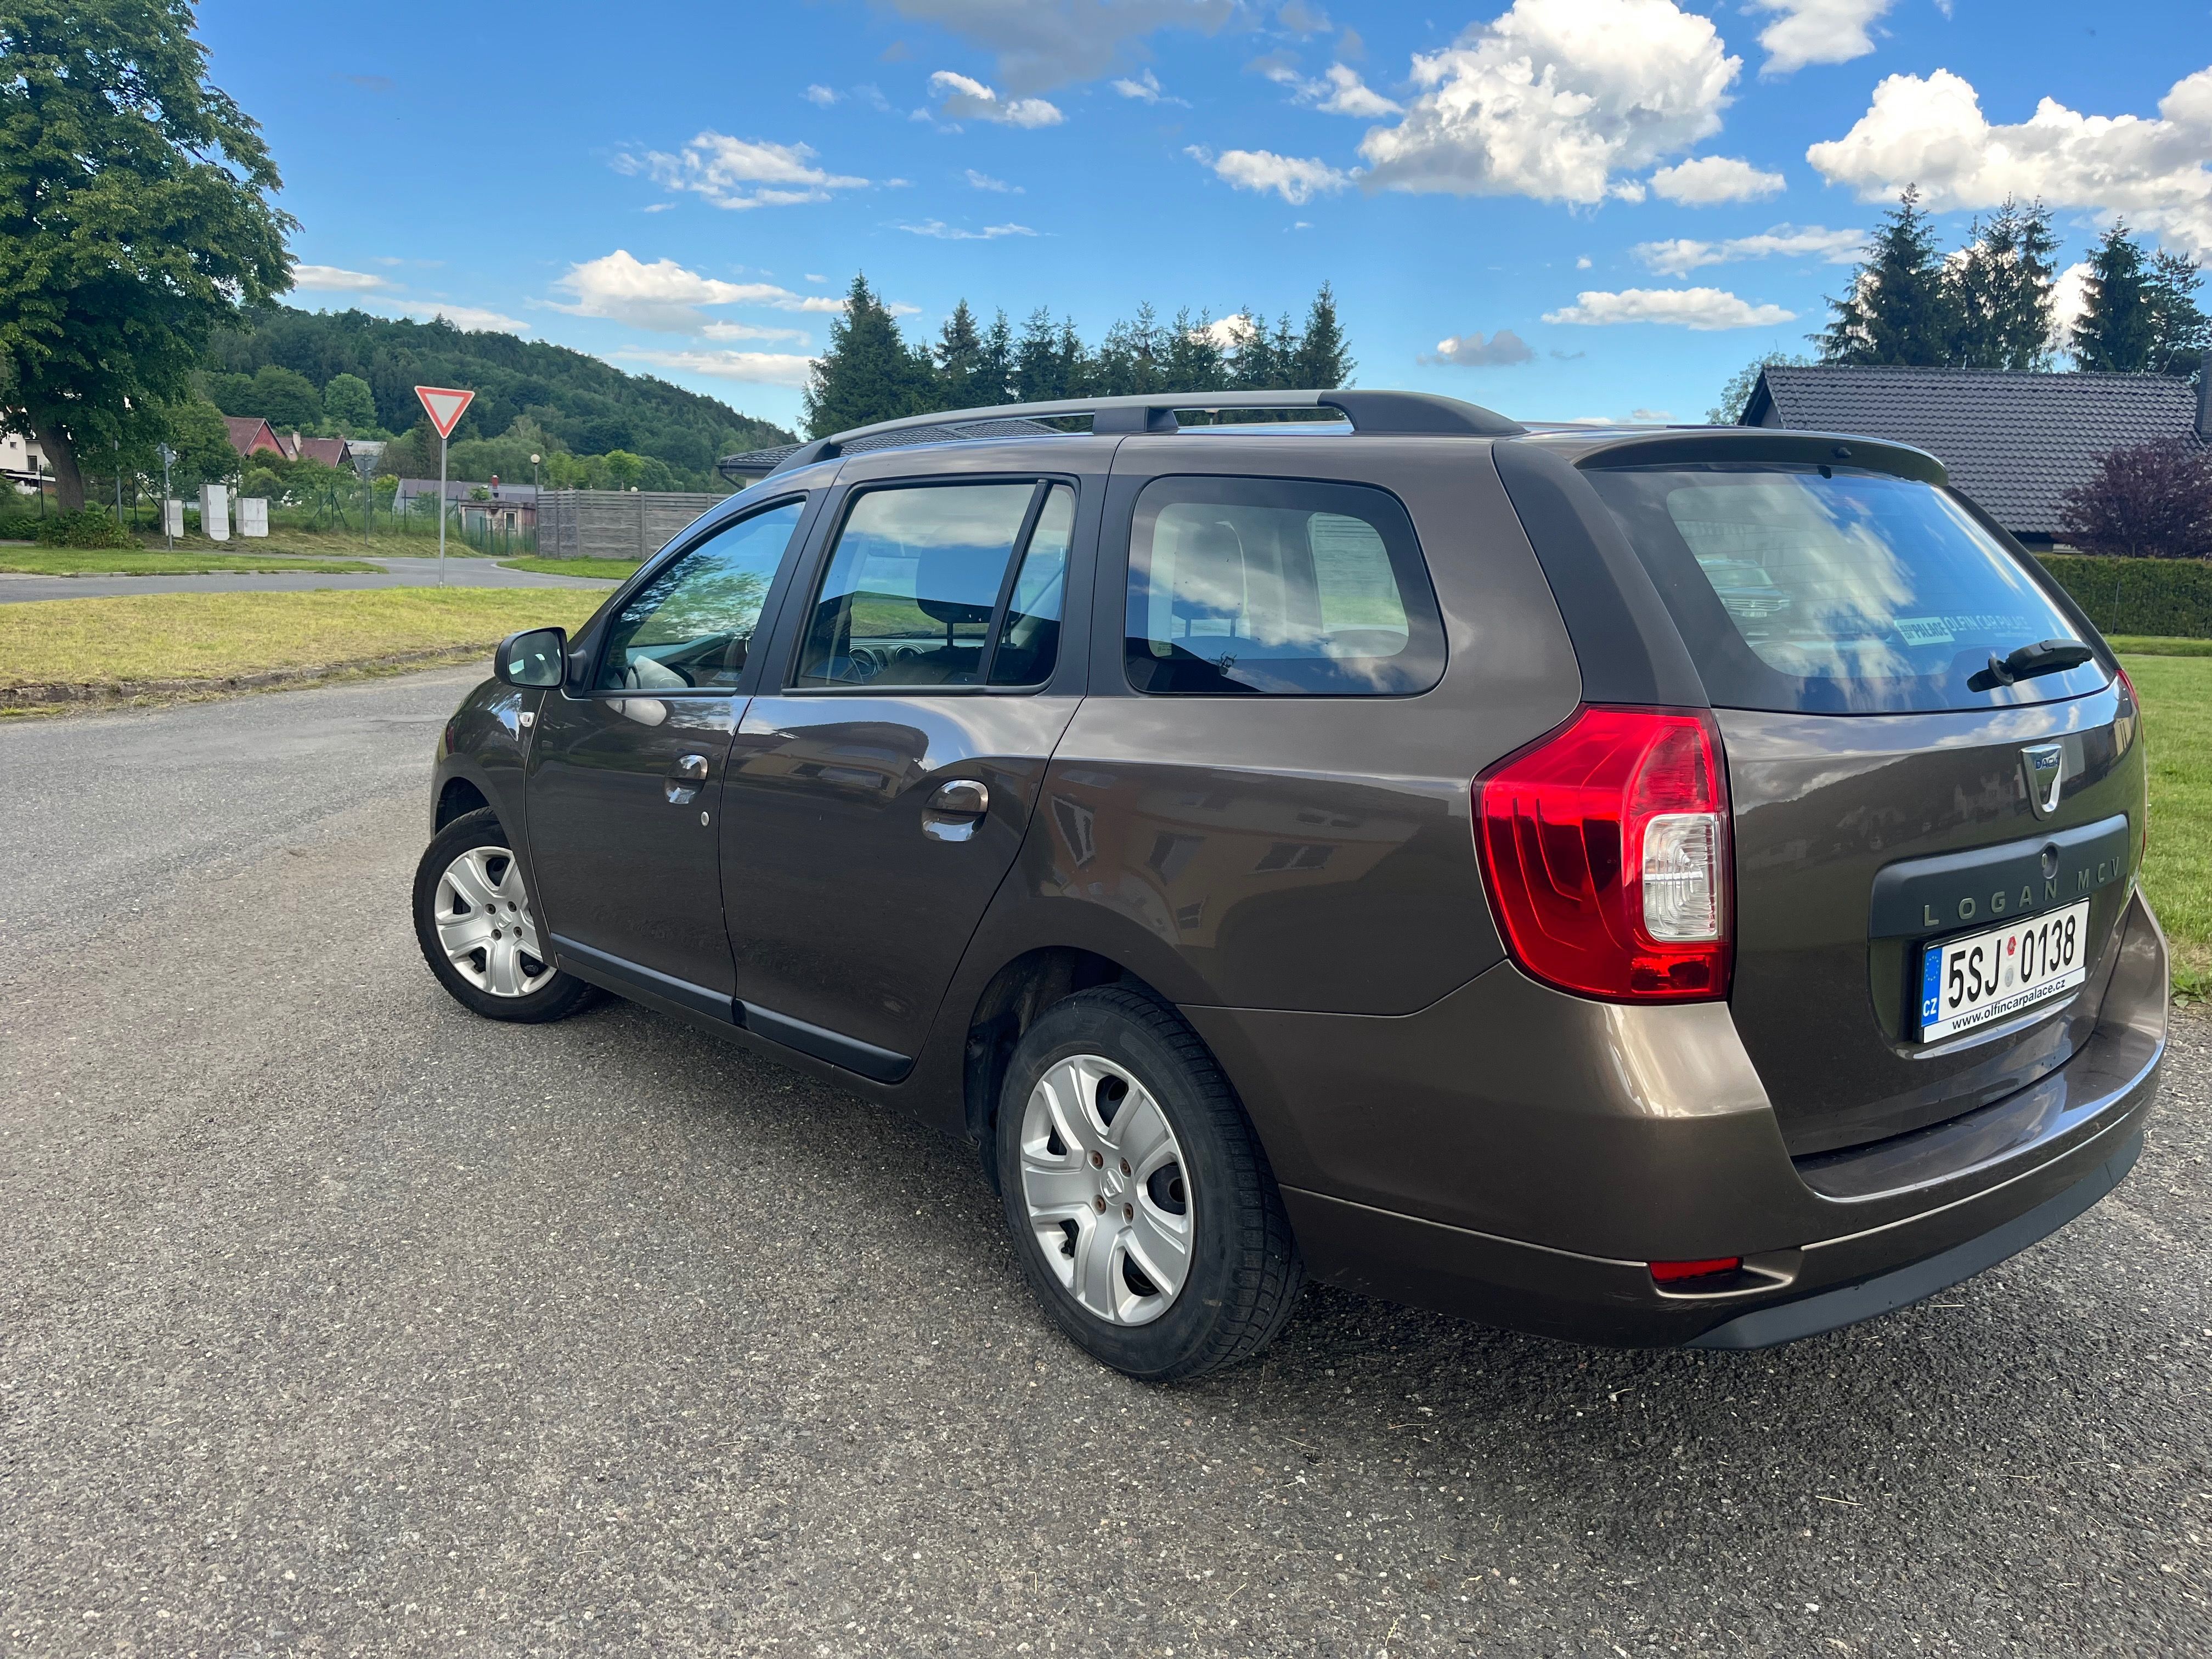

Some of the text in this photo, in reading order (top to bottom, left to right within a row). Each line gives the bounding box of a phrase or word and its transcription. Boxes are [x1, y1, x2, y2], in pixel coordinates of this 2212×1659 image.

[1911, 622, 1949, 639] PALACE
[1924, 856, 2119, 927] LOGAN MCV
[1948, 914, 2076, 1008] 5SJ 0138
[1922, 997, 1937, 1017] CZ
[1952, 978, 2066, 1030] www.olfincarpalace.cz
